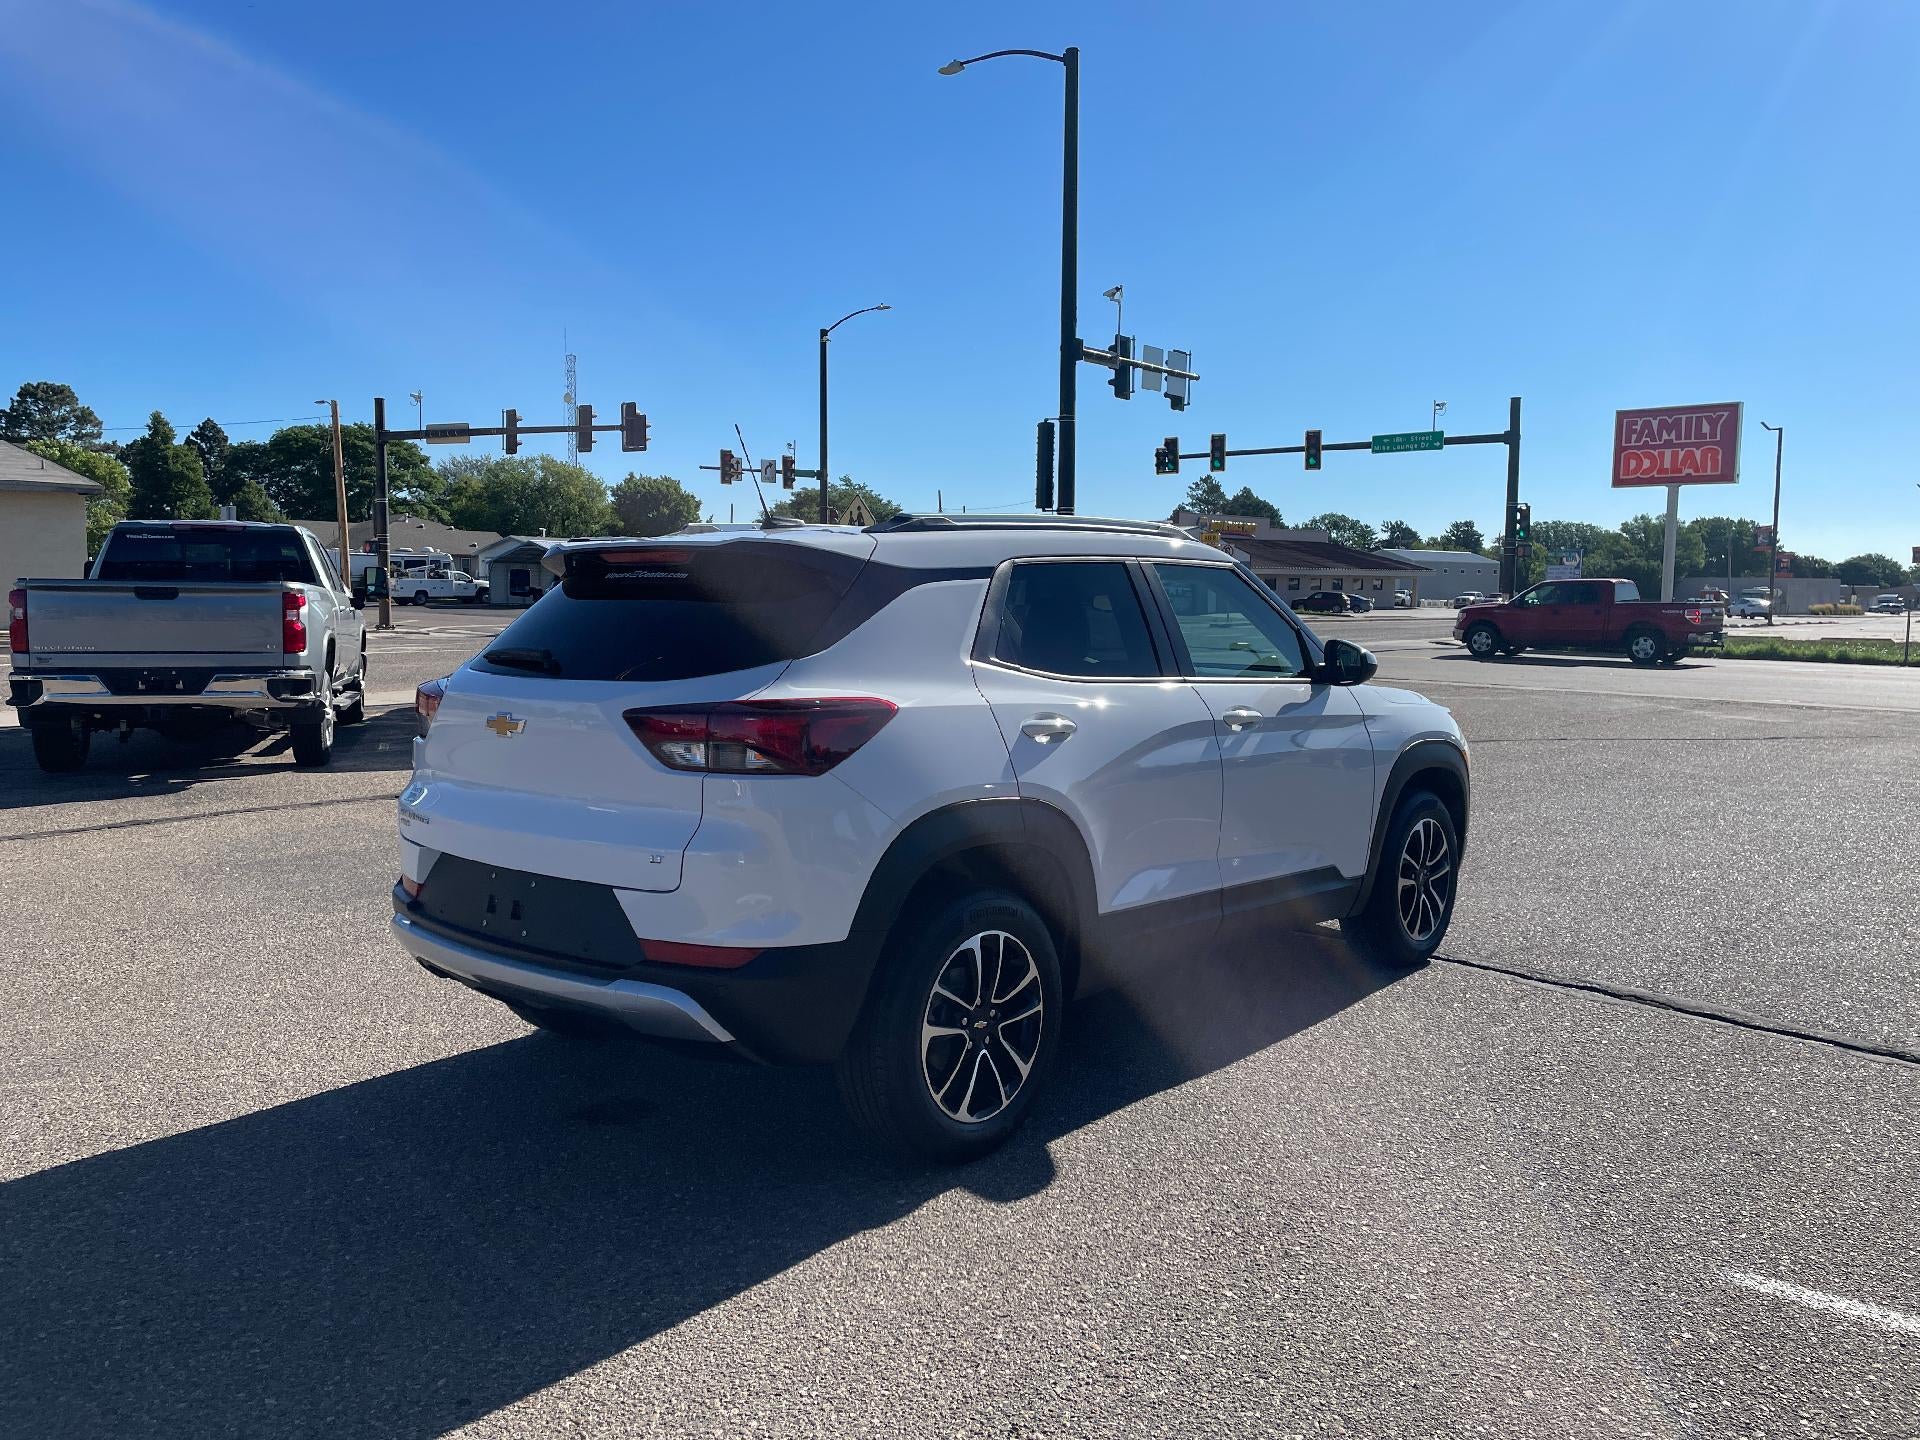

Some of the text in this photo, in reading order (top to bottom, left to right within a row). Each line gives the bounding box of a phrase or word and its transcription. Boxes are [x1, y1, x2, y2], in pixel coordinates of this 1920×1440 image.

[1410, 434, 1433, 442] Street
[1622, 412, 1730, 446] FAMILY
[1620, 446, 1722, 478] DOLLAR
